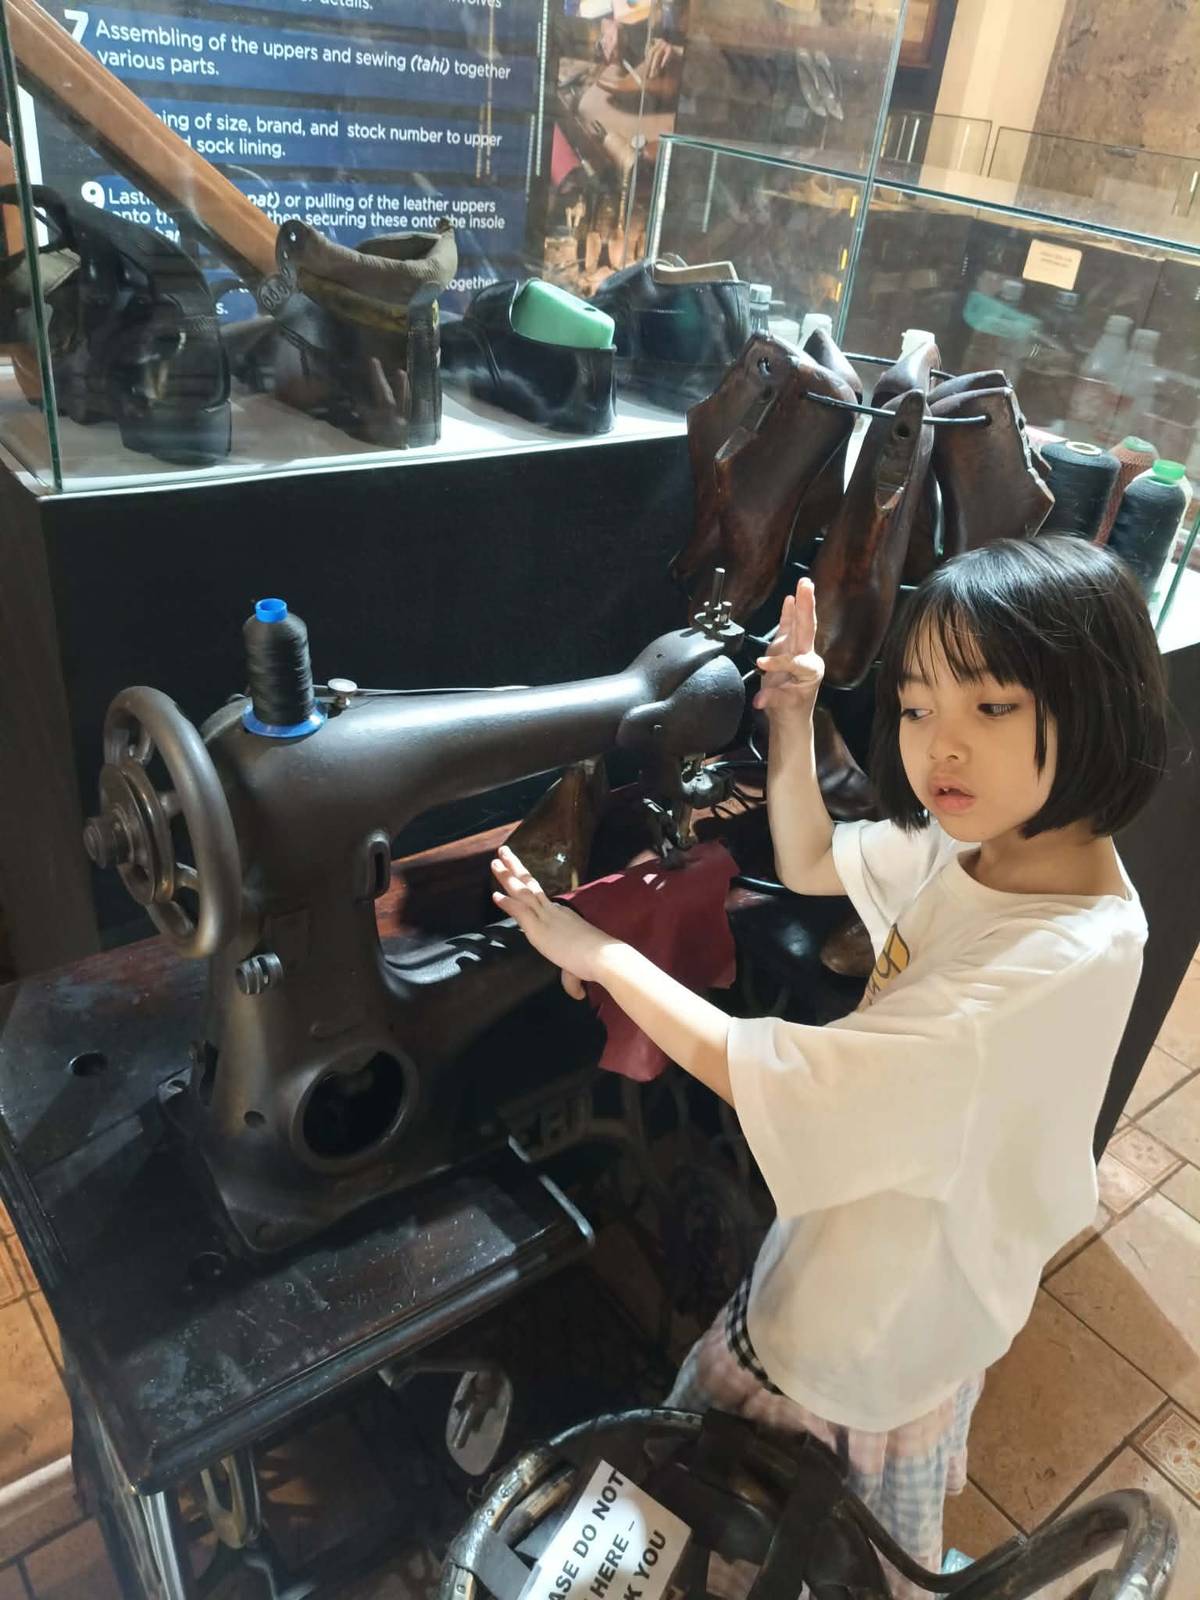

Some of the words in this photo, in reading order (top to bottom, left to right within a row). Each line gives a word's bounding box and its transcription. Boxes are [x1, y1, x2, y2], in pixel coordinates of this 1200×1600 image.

[64, 9, 89, 44] 7
[96, 19, 203, 52] Assembling
[208, 34, 227, 52] of
[232, 36, 259, 55] the
[263, 40, 318, 60] uppers
[323, 46, 351, 64] and
[356, 50, 406, 72] sewing
[410, 55, 450, 76] (tahi)
[454, 60, 511, 80] together
[98, 49, 164, 72] various
[171, 55, 219, 76] parts.
[194, 112, 212, 130] of
[216, 114, 252, 134] size,
[256, 115, 305, 137] brand,
[311, 120, 339, 137] and
[347, 124, 386, 140] stock
[390, 128, 442, 144] number
[446, 130, 460, 145] to
[464, 133, 502, 149] upper
[196, 136, 235, 154] sock
[239, 138, 286, 159] lining.
[81, 181, 105, 209] 9
[108, 187, 155, 206] Last
[285, 195, 302, 208] or
[305, 192, 354, 213] pulling
[360, 195, 375, 210] of
[378, 194, 400, 211] the
[403, 195, 449, 212] leather
[452, 200, 496, 214] uppers
[305, 211, 366, 230] securing
[371, 211, 408, 228] these
[469, 214, 505, 230] insole
[573, 1524, 597, 1558] DO
[592, 1470, 624, 1521] NOT
[590, 1534, 630, 1598] HERE
[633, 1529, 666, 1580] YOU
